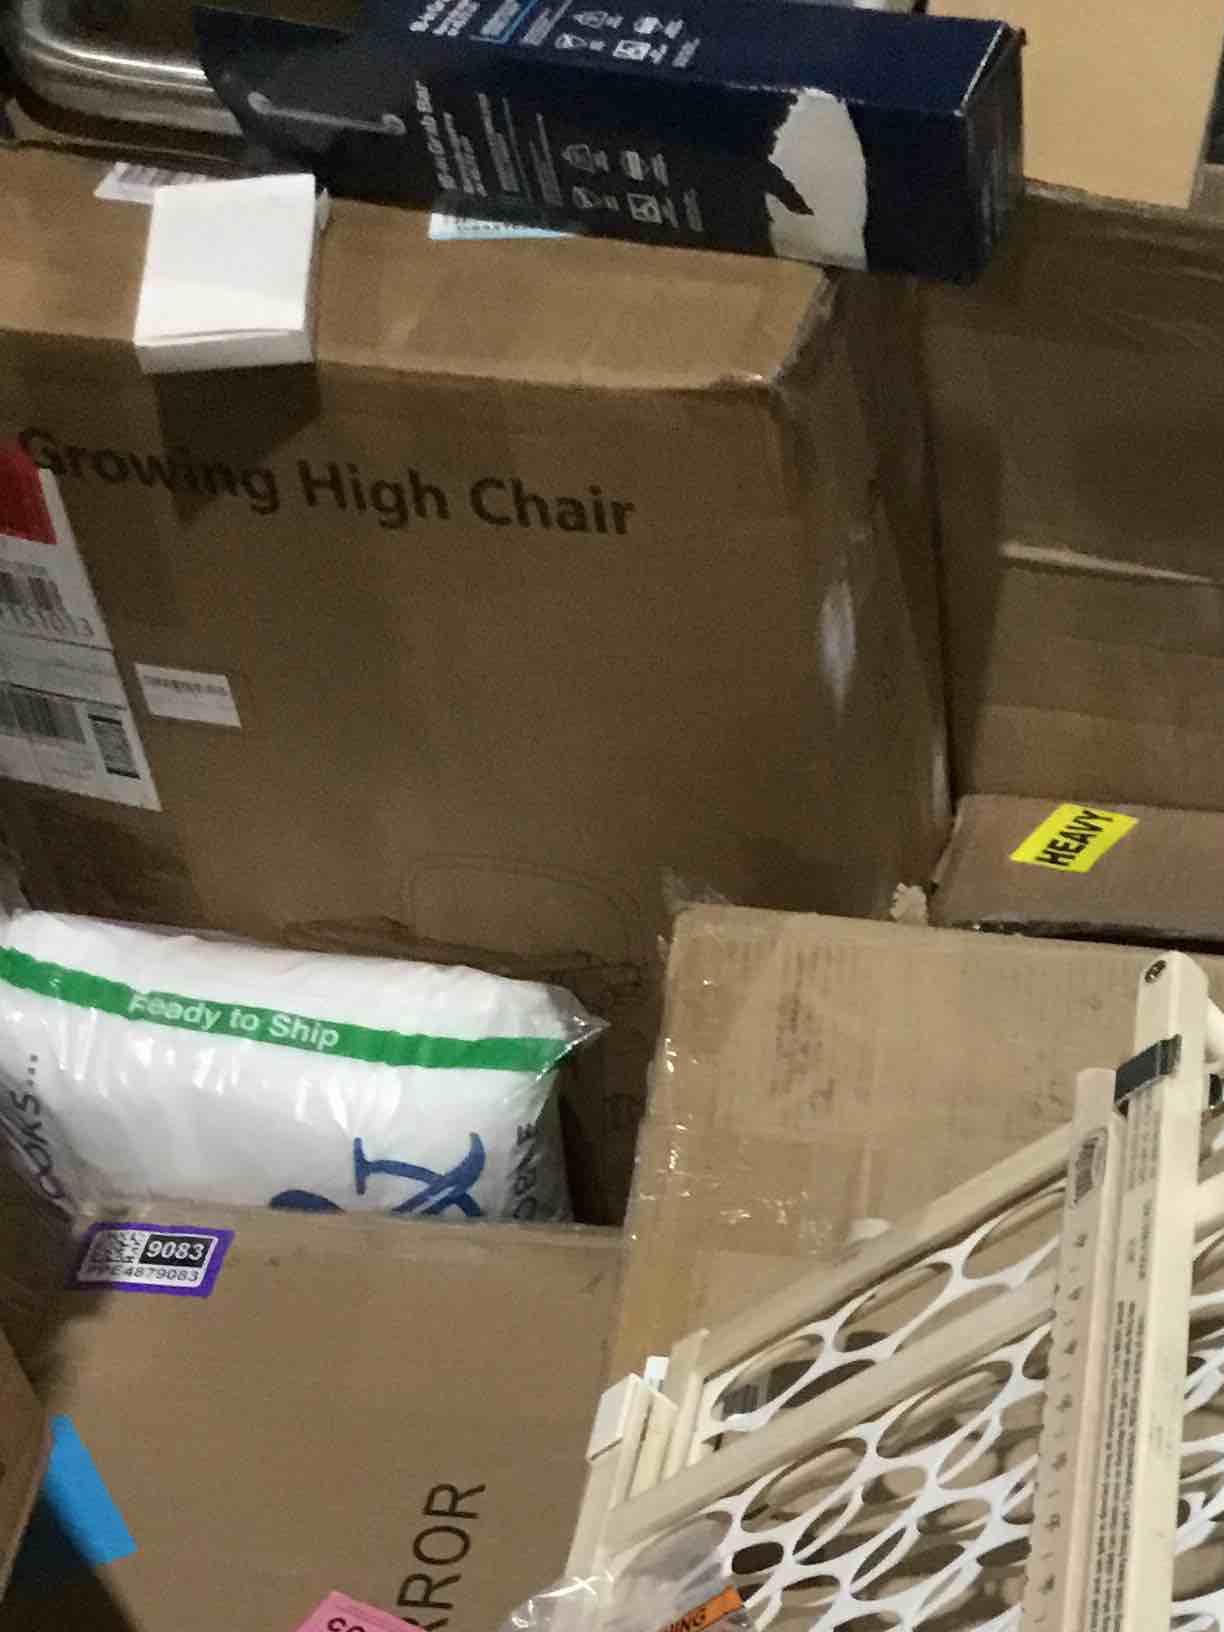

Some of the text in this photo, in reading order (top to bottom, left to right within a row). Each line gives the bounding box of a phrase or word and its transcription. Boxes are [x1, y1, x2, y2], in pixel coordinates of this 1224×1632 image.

[18, 426, 636, 535] Growing High Chair
[1034, 808, 1114, 867] HEAVY
[128, 993, 340, 1050] Ready to Ship
[146, 1240, 205, 1261] 9083
